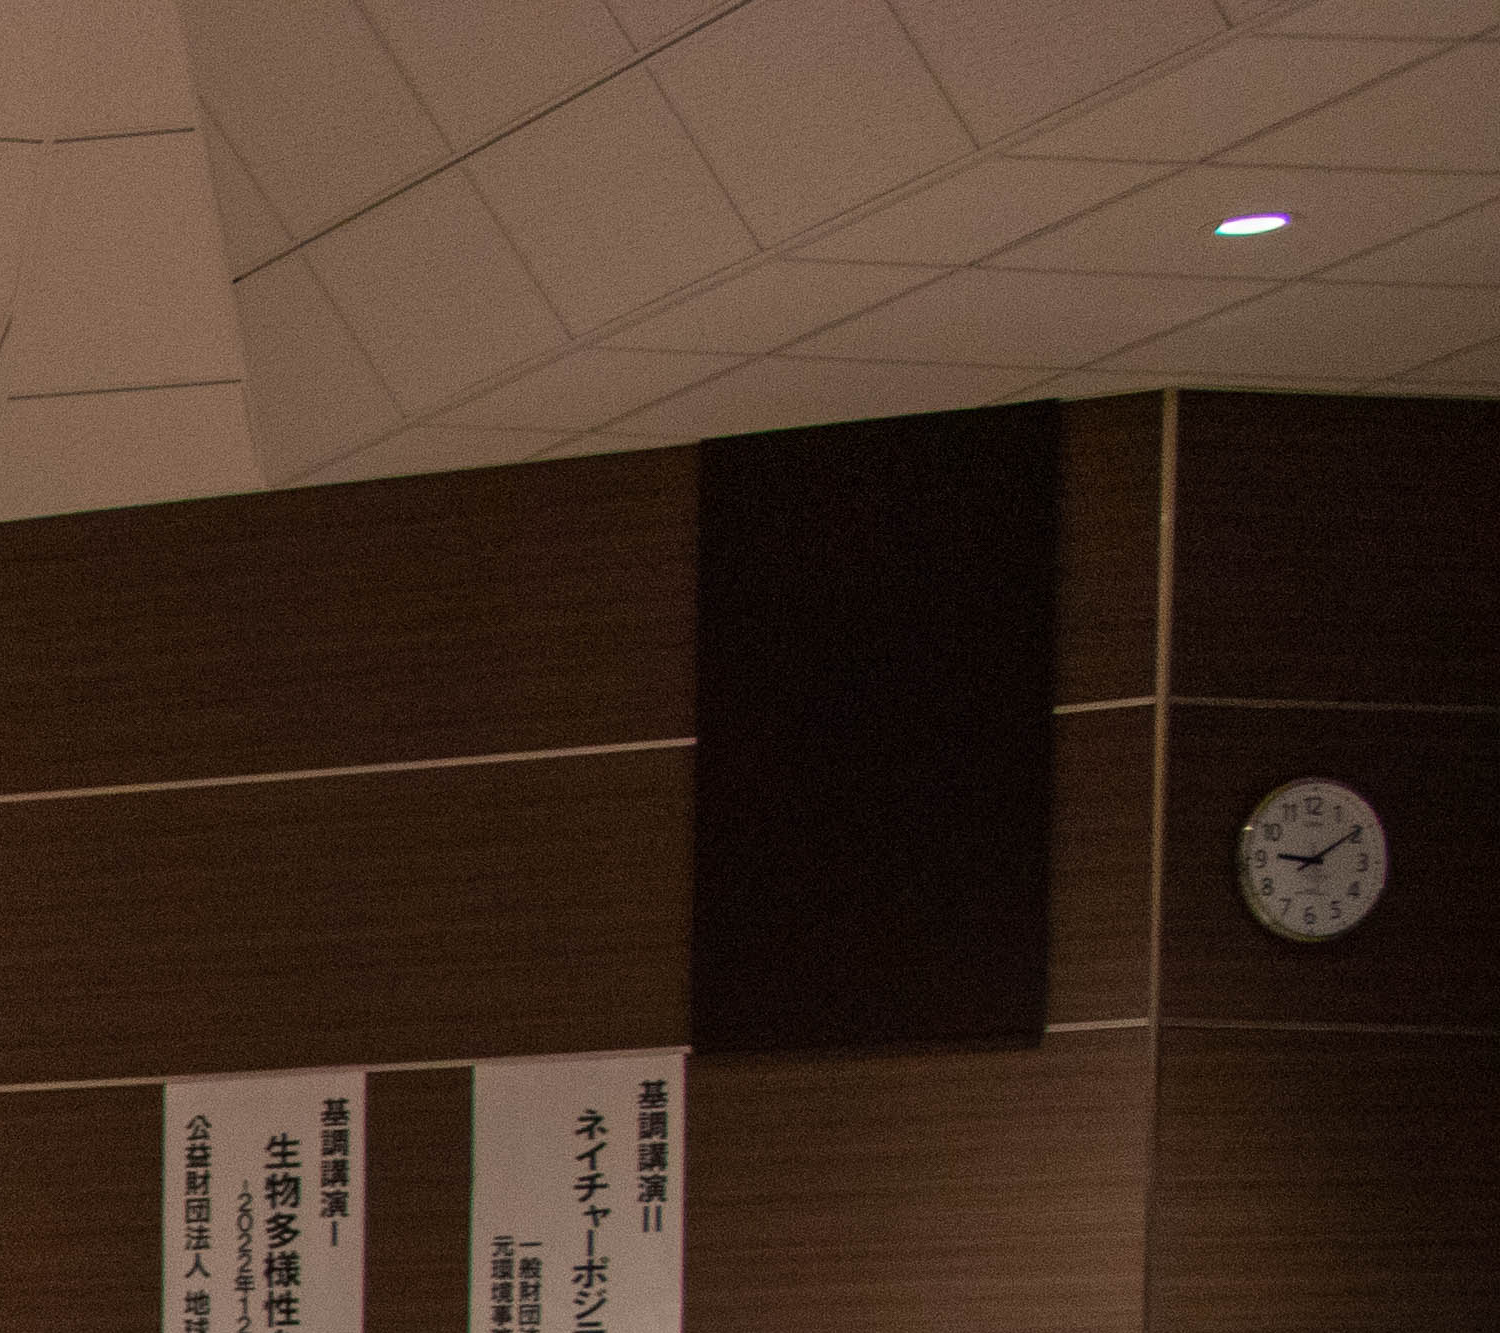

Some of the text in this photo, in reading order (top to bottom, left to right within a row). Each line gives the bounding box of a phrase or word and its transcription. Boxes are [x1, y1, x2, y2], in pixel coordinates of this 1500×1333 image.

[1304, 796, 1324, 816] 12
[1254, 849, 1267, 868] 9
[1357, 852, 1369, 873] 3
[1346, 881, 1361, 900] 4
[1281, 898, 1292, 916] 7
[1303, 907, 1316, 925] 6
[1331, 900, 1342, 919] 5
[184, 1114, 212, 1279] 公益財団法人
